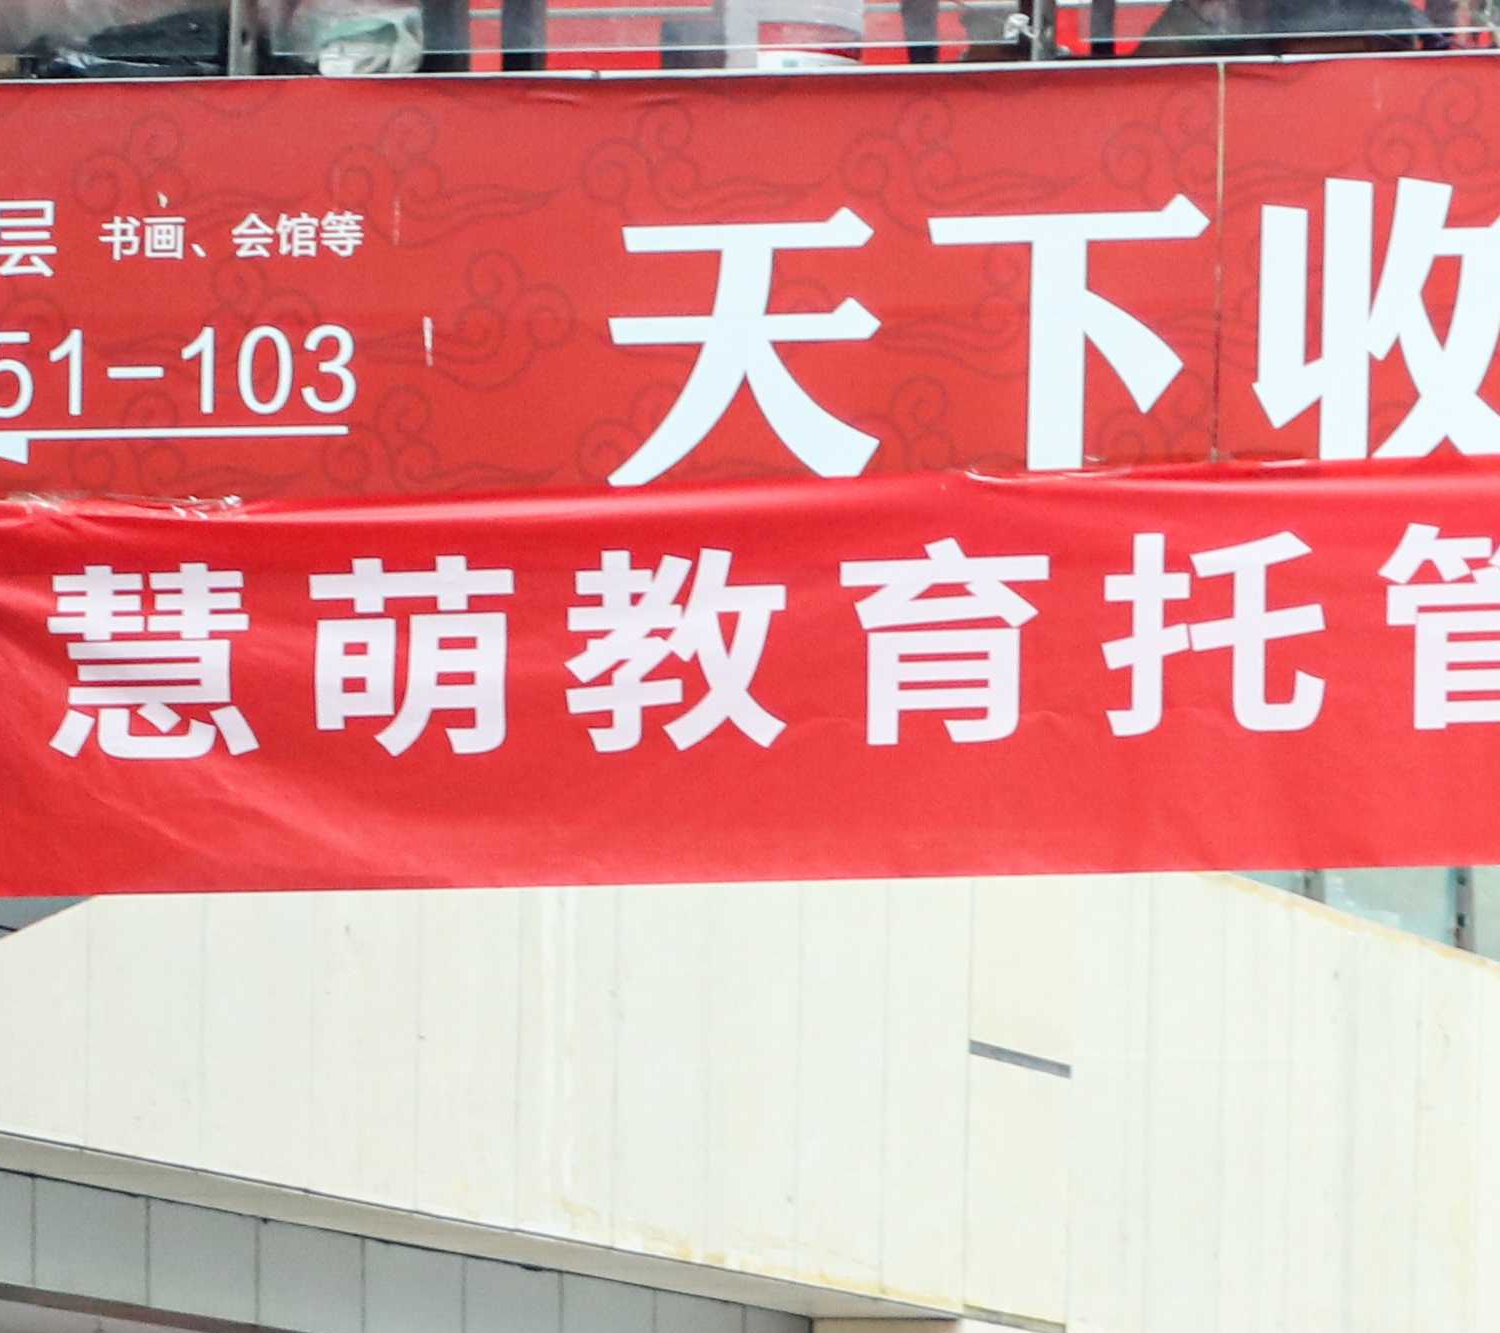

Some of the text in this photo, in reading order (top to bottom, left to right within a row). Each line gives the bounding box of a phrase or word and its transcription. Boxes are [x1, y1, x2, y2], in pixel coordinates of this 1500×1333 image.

[98, 210, 366, 261] 书画、会馆等
